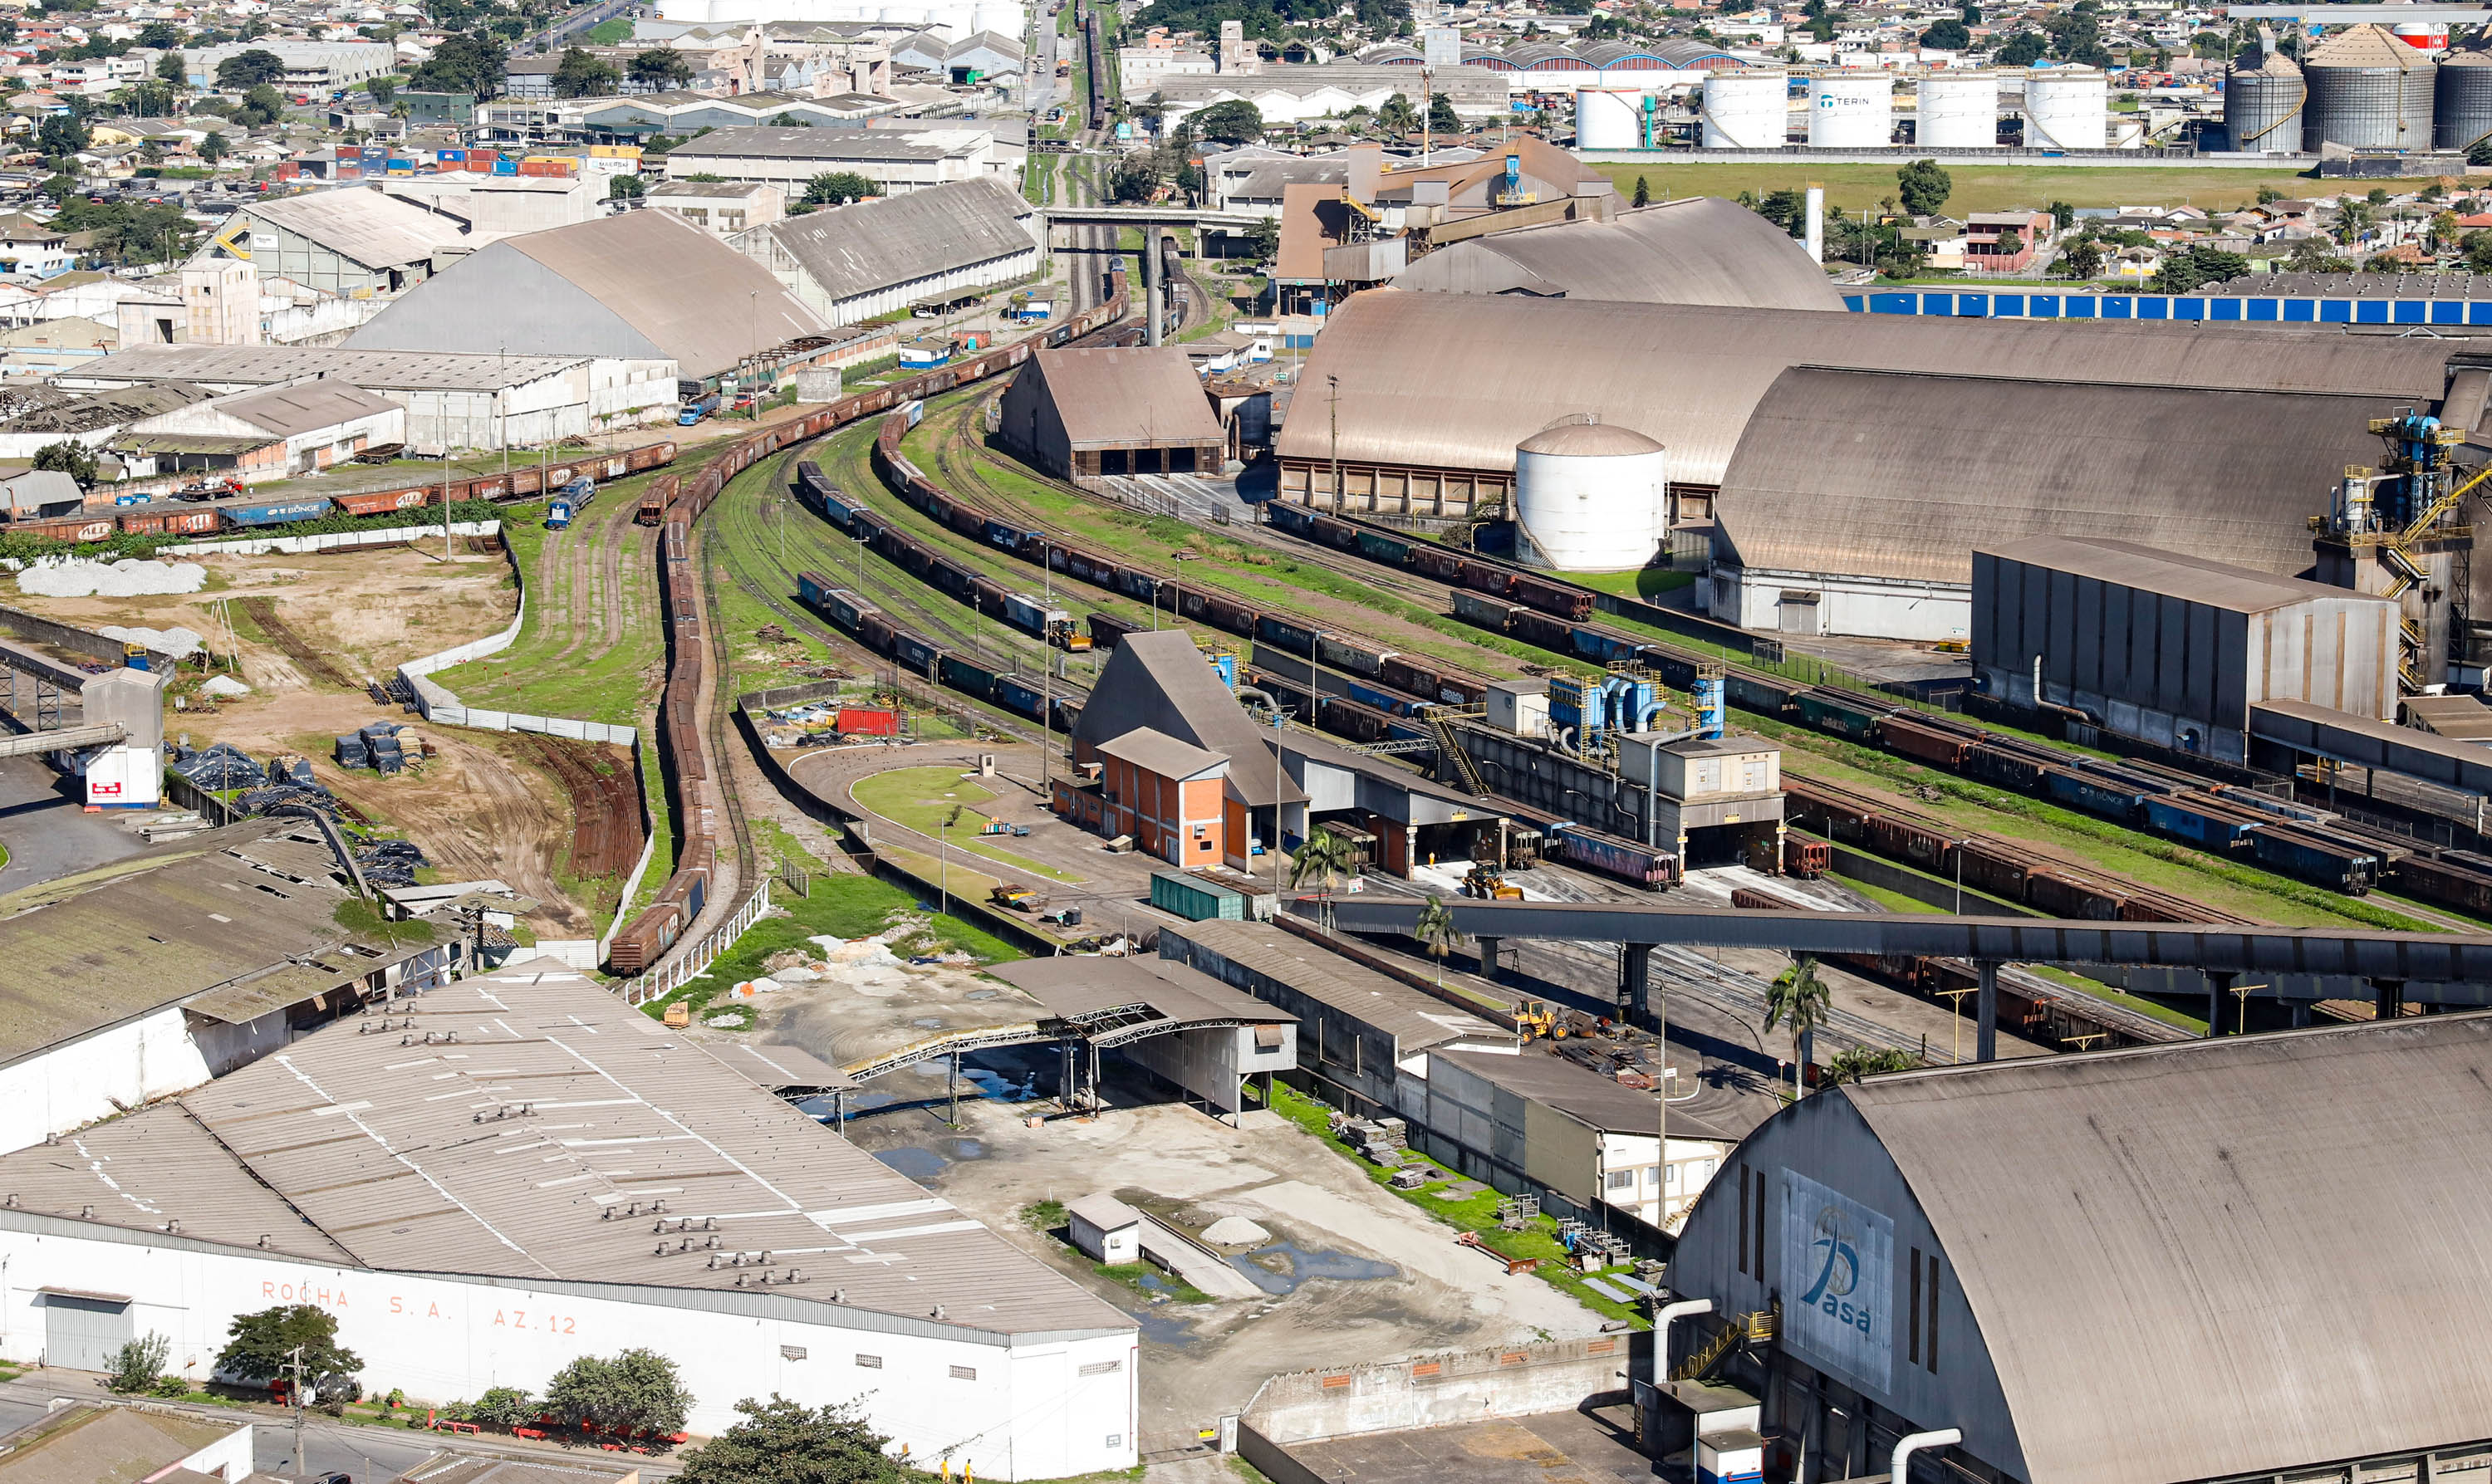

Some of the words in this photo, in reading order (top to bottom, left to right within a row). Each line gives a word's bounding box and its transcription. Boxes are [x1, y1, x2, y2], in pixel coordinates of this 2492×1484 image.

[287, 504, 320, 514] BUNGE
[2097, 790, 2124, 805] BUNGE
[261, 1281, 347, 1307] ROCHA
